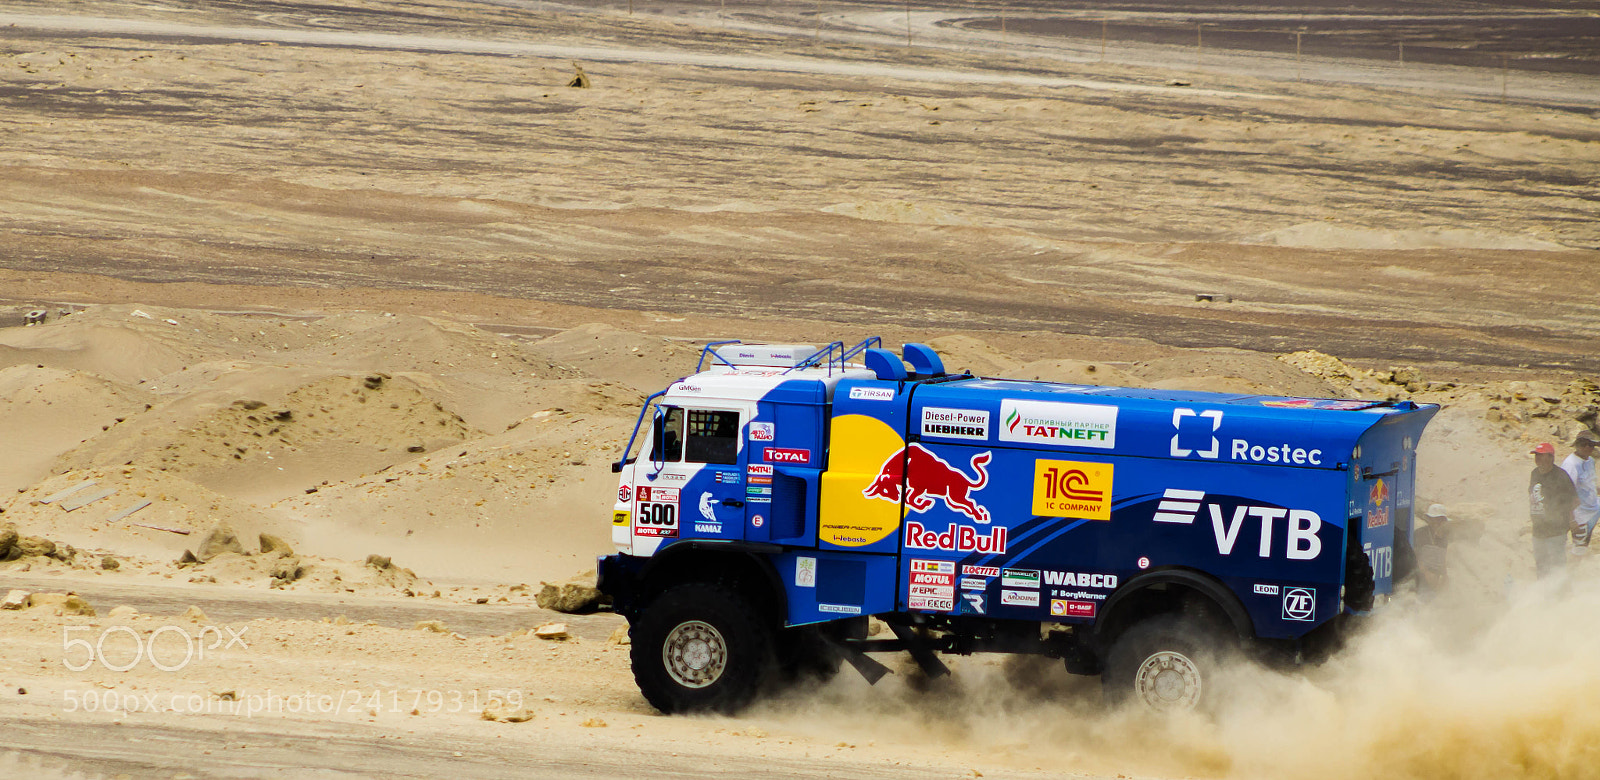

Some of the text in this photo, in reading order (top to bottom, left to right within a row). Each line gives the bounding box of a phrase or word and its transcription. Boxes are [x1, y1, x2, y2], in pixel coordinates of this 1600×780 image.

[925, 411, 986, 424] Diesel-Power
[1024, 417, 1110, 429] ТОПЛИВНЫЙ ПАРТНЕР
[924, 424, 985, 437] LIEBHERR
[1023, 425, 1109, 441] TATNEFT
[1231, 438, 1322, 466] Rostec
[1059, 502, 1102, 513] COMPANY
[639, 502, 675, 526] 500
[694, 523, 723, 533] KAMAZ
[1208, 503, 1322, 560] VTB
[833, 534, 867, 543] Webasto
[963, 566, 999, 576] LOCTITE
[914, 573, 950, 585] MOTUL
[1043, 570, 1118, 589] WABCO
[1060, 589, 1107, 600] BorgWarner
[1254, 585, 1279, 594] LEONI
[1288, 594, 1309, 613] ZF
